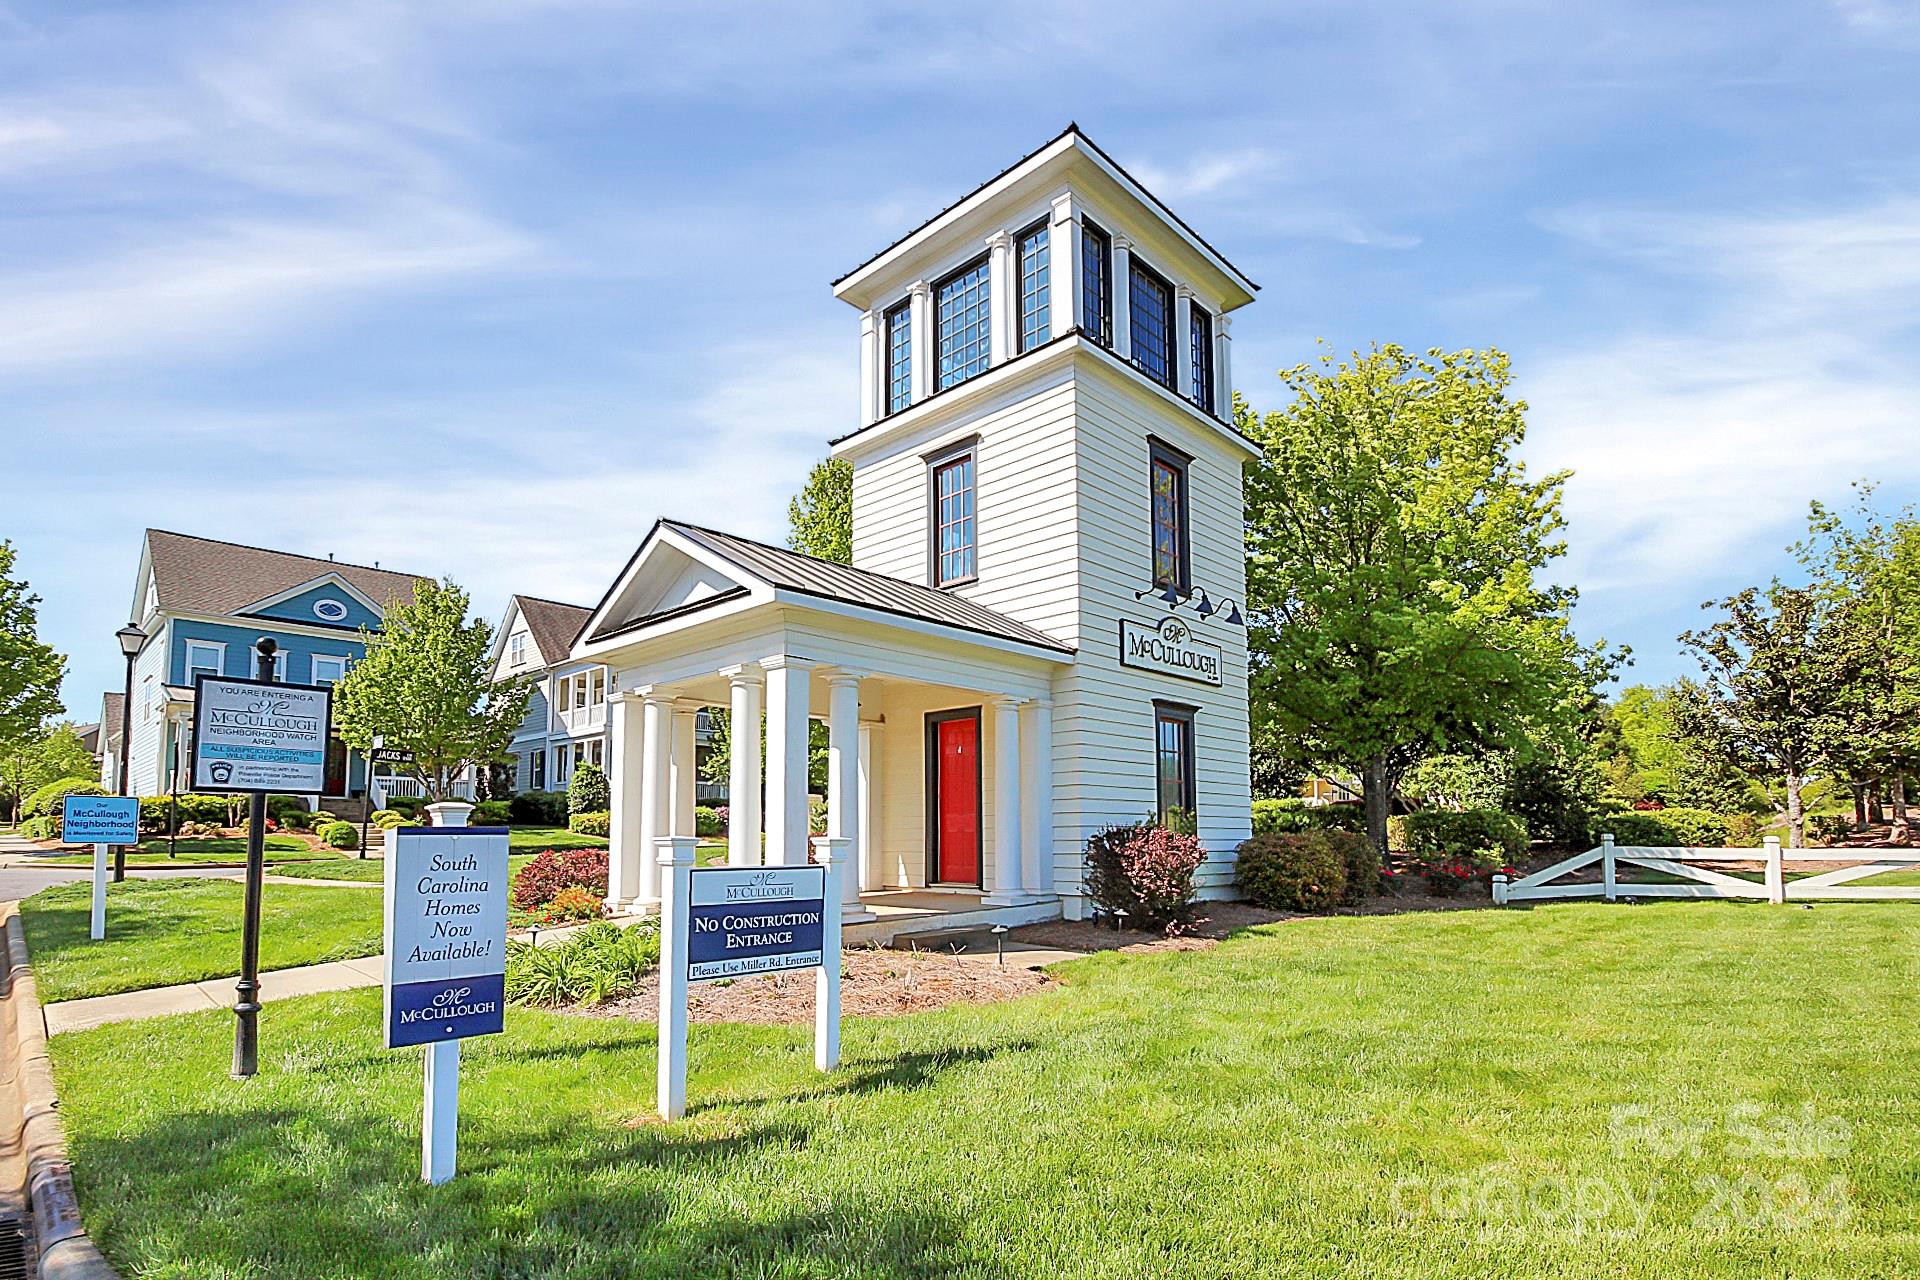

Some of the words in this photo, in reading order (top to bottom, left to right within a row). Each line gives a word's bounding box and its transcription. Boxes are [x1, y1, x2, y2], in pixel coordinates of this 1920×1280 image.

[1128, 631, 1217, 675] McCULLOUGH
[220, 686, 240, 695] YOU
[261, 690, 306, 701] ENTERING
[210, 711, 317, 731] McCULLOUGH
[209, 727, 285, 739] NEIGHBORHOOD
[287, 732, 317, 741] WATCH
[252, 738, 277, 746] AREA
[227, 746, 275, 755] SUSPICIOUS
[275, 749, 315, 758] ACTIVITIES
[260, 754, 300, 762] REPORTED
[376, 750, 400, 760] JACKS
[73, 810, 130, 819] McCullough
[67, 820, 134, 829] Neighborhood
[430, 854, 478, 872] South
[417, 877, 489, 894] Carolina
[726, 887, 794, 899] McCULLOUGH
[424, 900, 481, 917] Homes
[430, 921, 473, 939] Now
[695, 917, 719, 933] NO
[722, 912, 819, 930] CONSTRUCTION
[726, 932, 793, 949] ENTRANCE
[407, 940, 492, 963] Available!
[692, 965, 720, 977] Please
[723, 963, 739, 974] Use
[741, 960, 767, 971] Miller
[769, 957, 783, 967] Rd.
[785, 954, 819, 966] Entrance
[400, 1001, 495, 1024] McCULLOUGH
